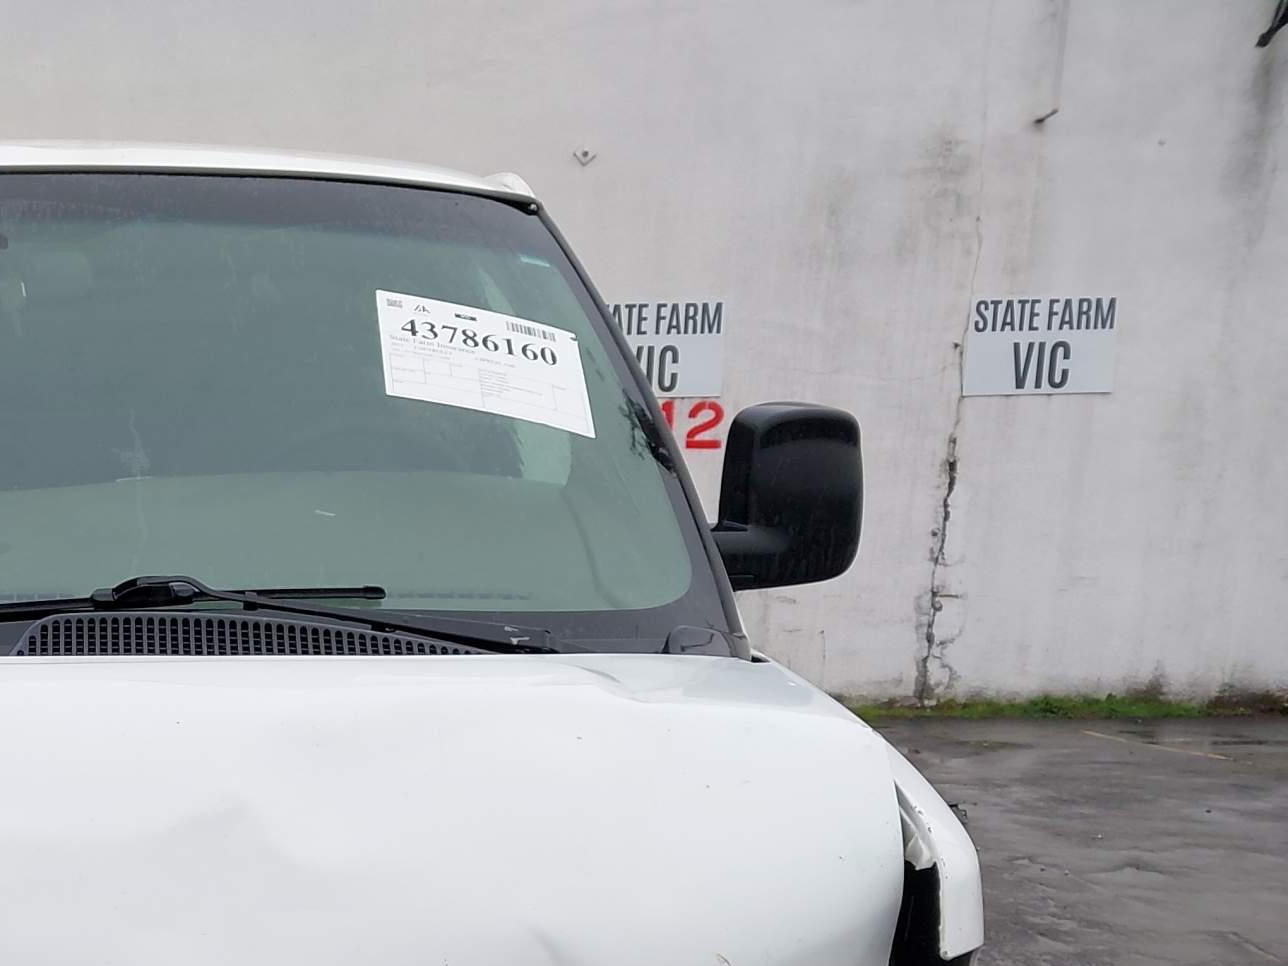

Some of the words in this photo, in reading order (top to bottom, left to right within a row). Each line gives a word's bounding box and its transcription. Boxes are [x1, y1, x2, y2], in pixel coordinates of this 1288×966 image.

[607, 303, 649, 335] ATE
[655, 301, 723, 335] FARM
[974, 299, 1041, 333] STATE
[1047, 297, 1117, 331] FARM
[400, 319, 558, 366] 43786160
[1013, 340, 1072, 390] VIC
